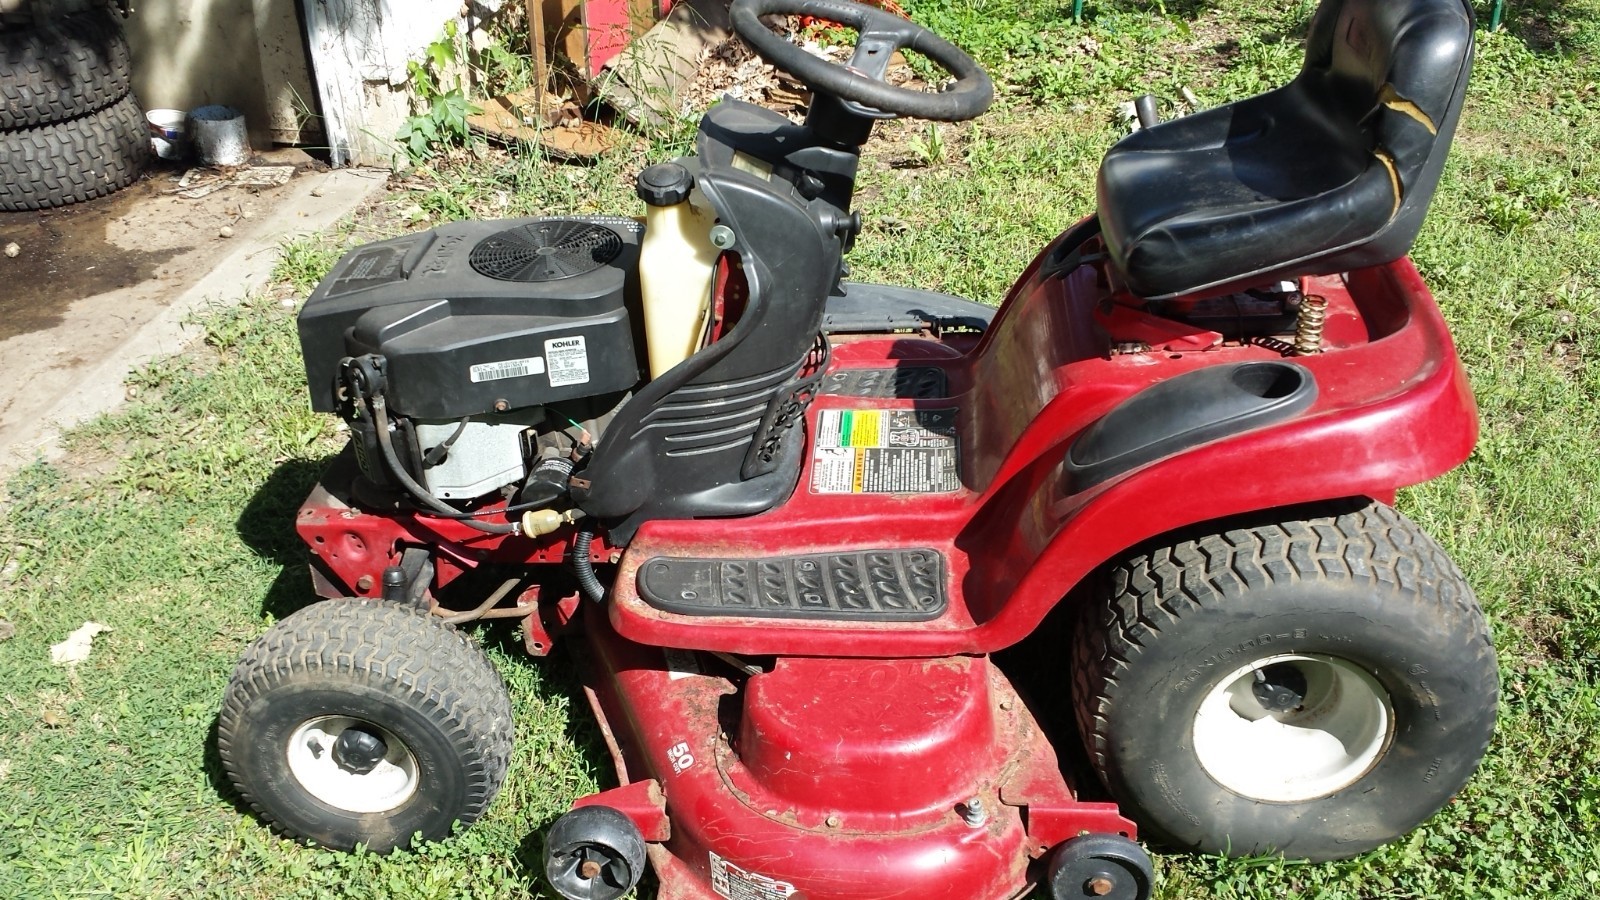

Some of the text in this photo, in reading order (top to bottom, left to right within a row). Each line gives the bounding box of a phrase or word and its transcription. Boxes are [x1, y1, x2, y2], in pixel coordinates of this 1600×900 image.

[552, 339, 580, 349] KOHLER
[812, 462, 822, 485] DANGER
[855, 452, 864, 482] WARNING
[672, 742, 694, 769] 50
[672, 762, 682, 774] CUT
